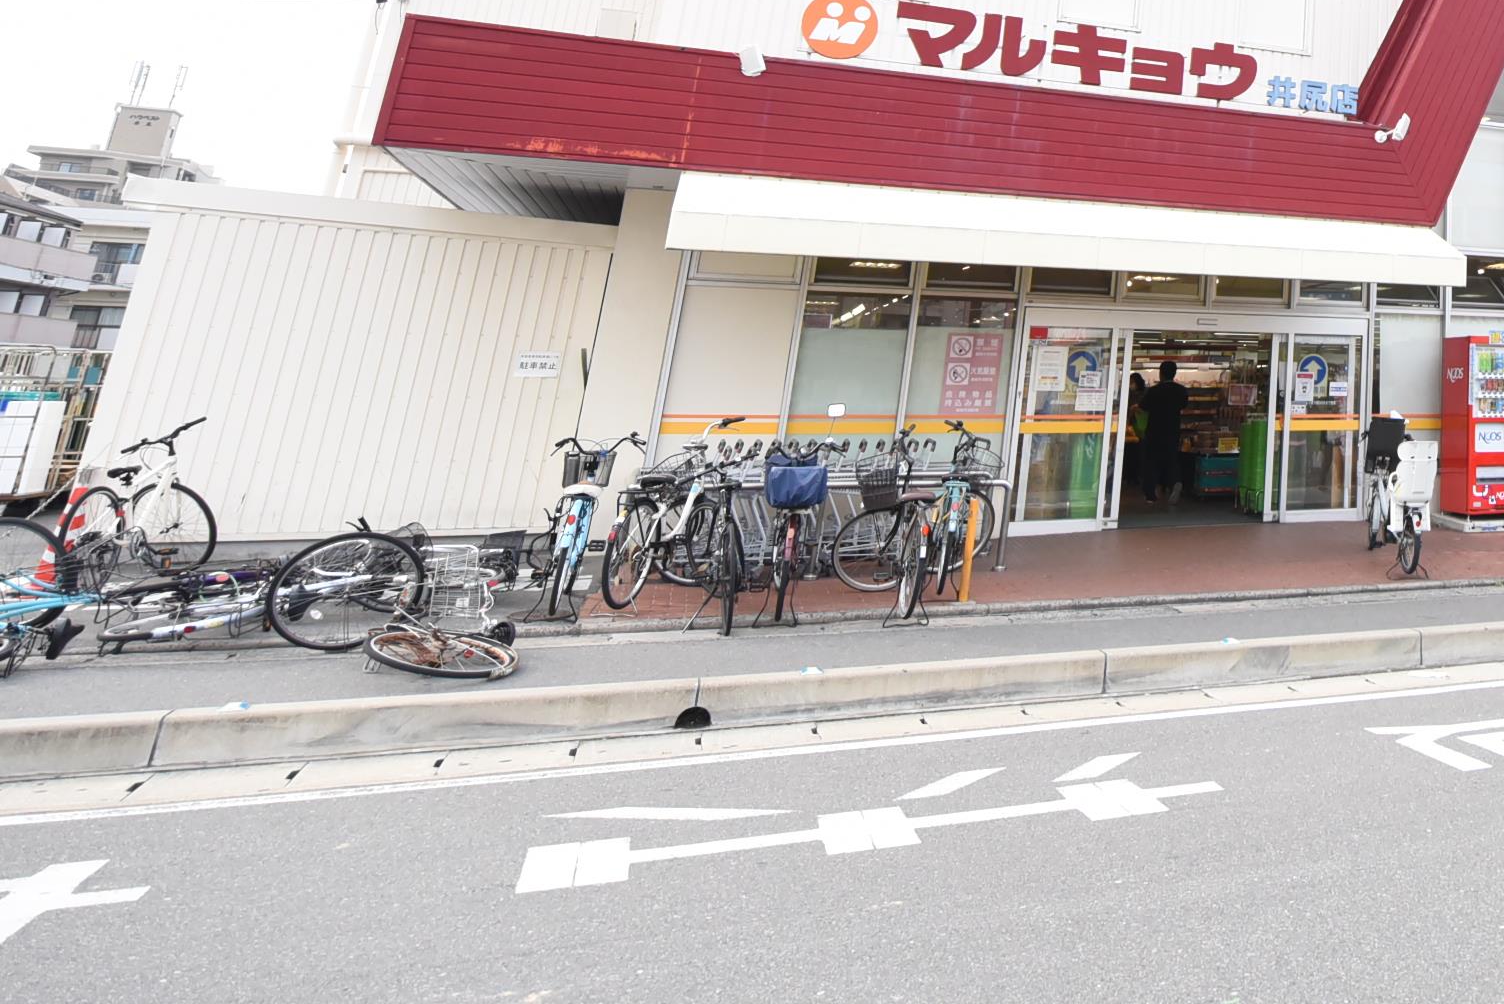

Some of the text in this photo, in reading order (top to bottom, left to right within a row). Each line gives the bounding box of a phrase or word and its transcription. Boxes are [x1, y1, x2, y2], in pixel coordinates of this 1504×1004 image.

[896, 1, 1359, 116] マルキョウ 井尻店
[519, 361, 557, 370] 駐車禁止
